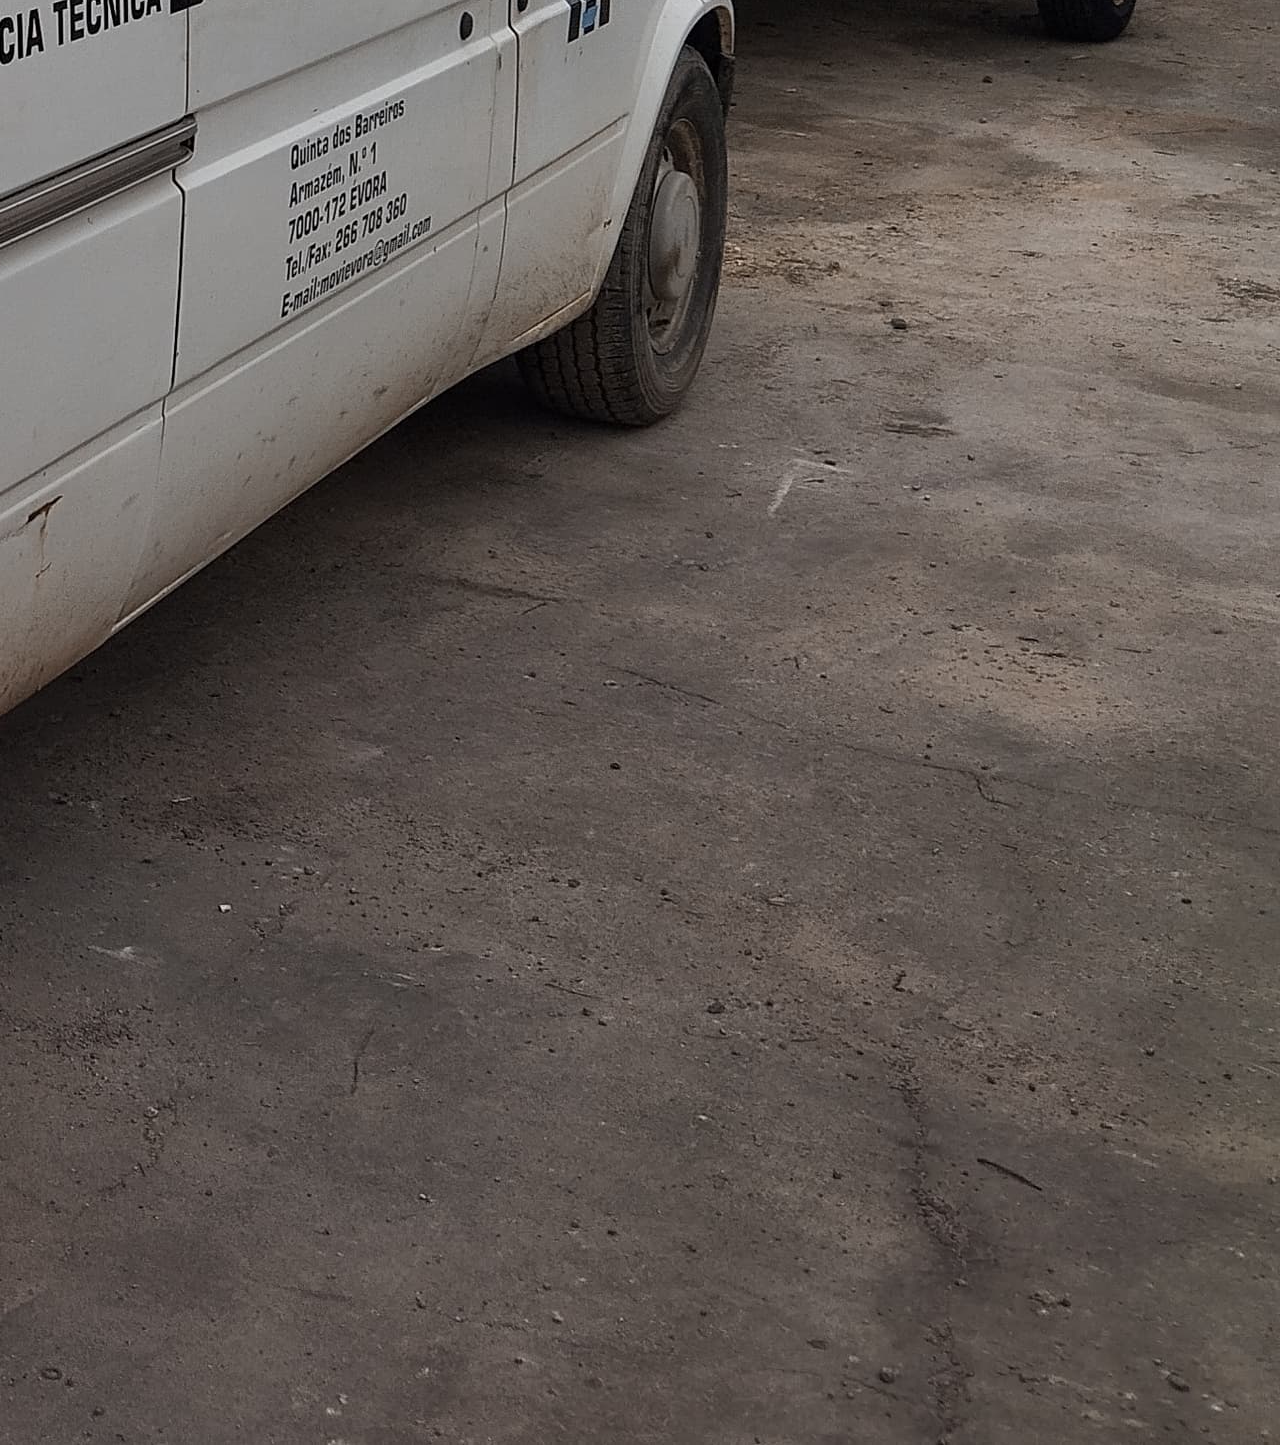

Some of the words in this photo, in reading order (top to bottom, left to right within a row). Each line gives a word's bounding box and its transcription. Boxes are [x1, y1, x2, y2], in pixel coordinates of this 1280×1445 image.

[290, 136, 329, 171] Quinta
[332, 124, 351, 150] dos
[354, 100, 405, 139] Barreiros
[288, 191, 347, 245] 7000-172
[350, 170, 388, 212] ÉVORA
[289, 162, 345, 208] Armazém,
[370, 140, 377, 165] 1
[285, 240, 332, 281] Tel./Fax:
[334, 220, 358, 253] 266
[361, 206, 383, 239] 708
[385, 192, 408, 224] 360
